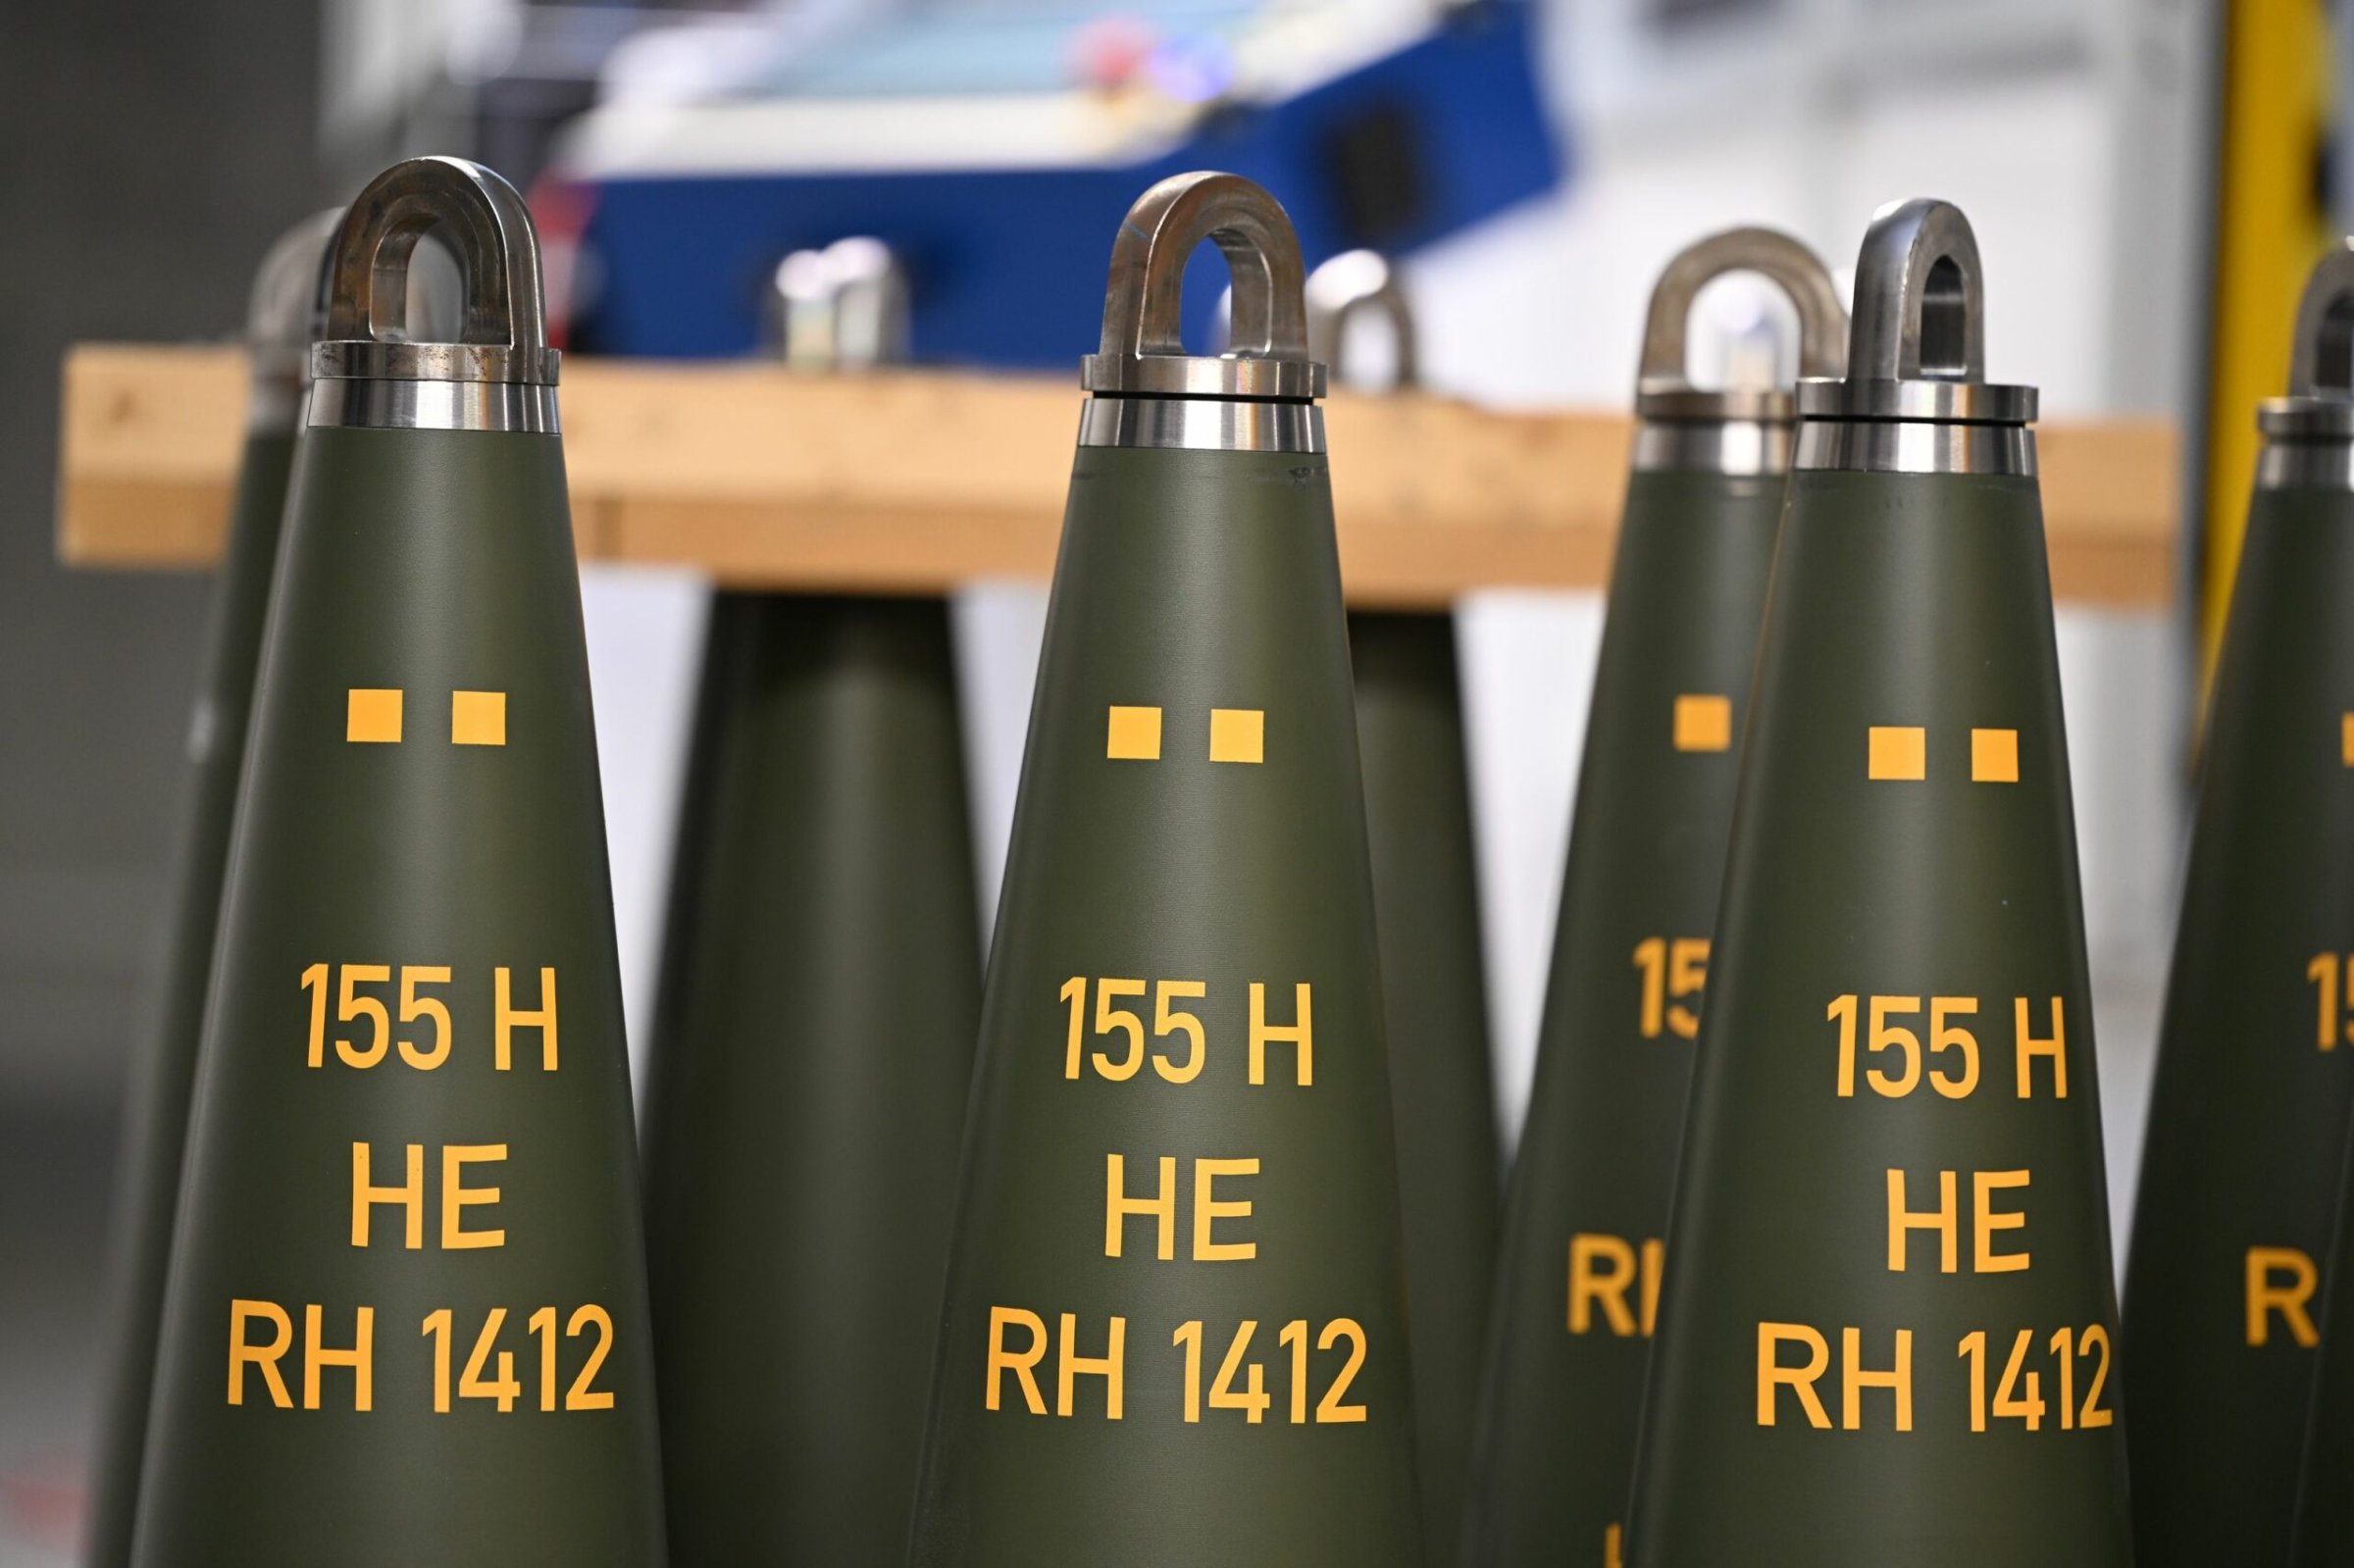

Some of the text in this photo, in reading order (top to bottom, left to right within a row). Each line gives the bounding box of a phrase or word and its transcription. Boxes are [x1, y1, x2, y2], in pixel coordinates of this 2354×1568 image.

[300, 963, 558, 1072] 155 H
[1059, 976, 1313, 1087] 155 H
[1826, 993, 2068, 1100] 155 H
[2306, 952, 2354, 1050] 1
[351, 1141, 508, 1250] HE
[1105, 1153, 1258, 1261] HE
[1887, 1167, 2030, 1274] HE
[227, 1298, 615, 1414] RH 1412
[985, 1305, 1367, 1425] RH 1412
[1757, 1321, 2114, 1433] RH 1412
